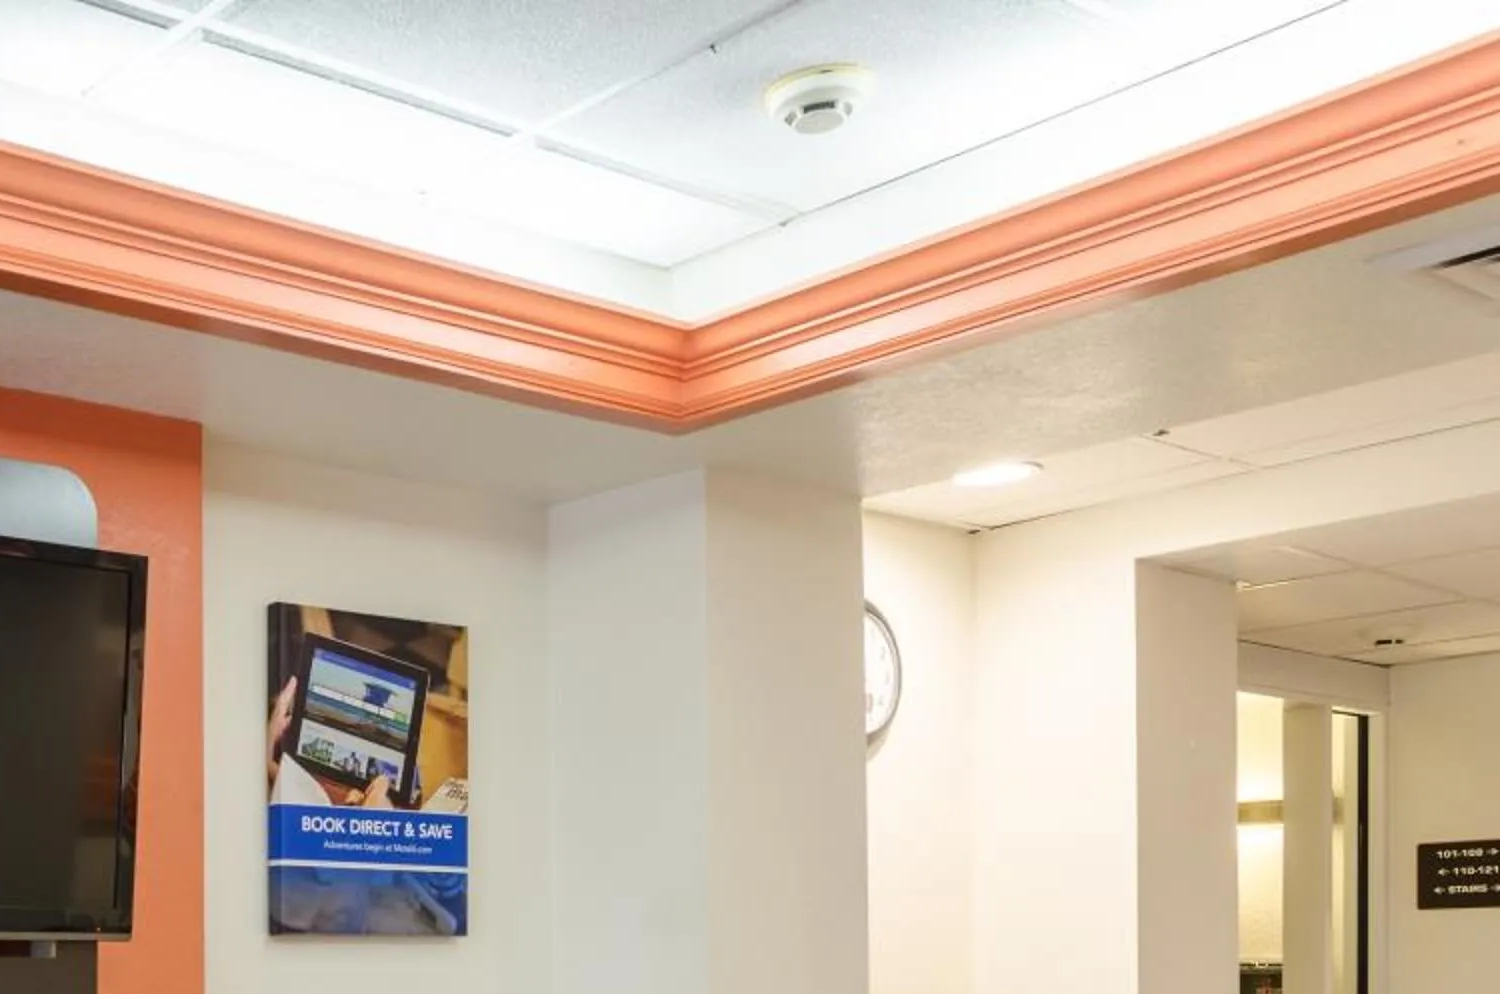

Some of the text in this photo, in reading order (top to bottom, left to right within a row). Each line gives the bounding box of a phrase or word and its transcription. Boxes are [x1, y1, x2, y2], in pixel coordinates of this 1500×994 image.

[301, 815, 453, 840] BOOK DIRECT & SAVE
[1448, 884, 1488, 894] STAIRS
